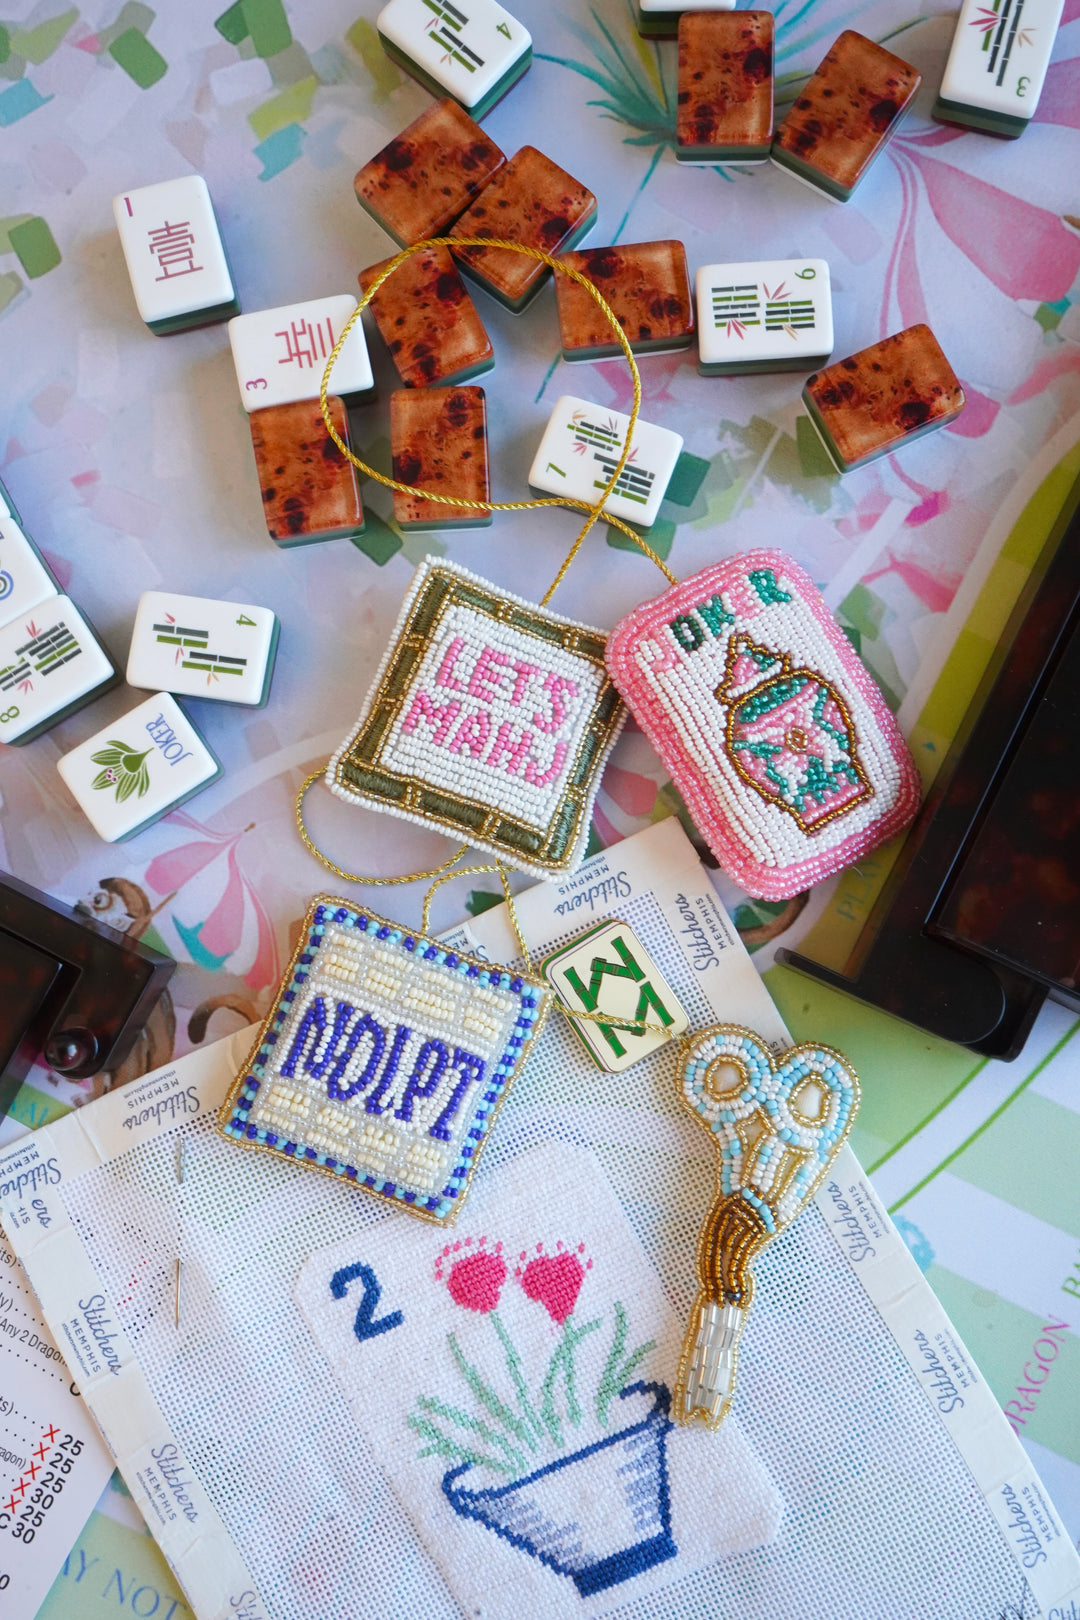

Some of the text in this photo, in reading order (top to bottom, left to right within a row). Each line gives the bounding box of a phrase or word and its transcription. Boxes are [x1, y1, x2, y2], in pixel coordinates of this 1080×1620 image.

[496, 22, 513, 41] 4
[1016, 76, 1032, 98] 3
[245, 377, 268, 392] 3
[545, 462, 567, 479] 7
[236, 613, 258, 627] 4
[437, 636, 579, 734] LETS
[0, 704, 21, 724] 8
[144, 712, 195, 767] JOKER
[401, 690, 568, 789] MAHJ
[553, 871, 632, 917] Stitchers
[558, 864, 610, 896] MEMPHIS
[674, 892, 720, 972] Stitchers
[695, 897, 727, 950] MEMPHIS
[122, 1085, 201, 1131] Stitchers
[127, 1078, 180, 1109] MEMPHIS
[826, 1180, 877, 1262] Stitchers
[848, 1185, 883, 1239] MEMPHIS
[329, 1261, 405, 1344] 2
[18, 1329, 31, 1344] 2
[69, 1317, 102, 1374] MEMPHIS
[77, 1293, 123, 1377] Stitchers
[913, 1328, 965, 1414] Stitchers
[934, 1333, 970, 1389] MEMPHIS
[32, 1441, 75, 1475] X 25
[42, 1423, 85, 1457] X 25
[12, 1477, 54, 1510] X 30
[23, 1460, 42, 1481] X
[40, 1471, 66, 1494] 25
[144, 1466, 178, 1521] MEMPHIS
[150, 1443, 200, 1524] Stitchers
[3, 1494, 46, 1528] X 25
[11, 1522, 36, 1544] 30
[1000, 1482, 1048, 1569] Stitchers
[1021, 1485, 1054, 1543] MEMPHIS
